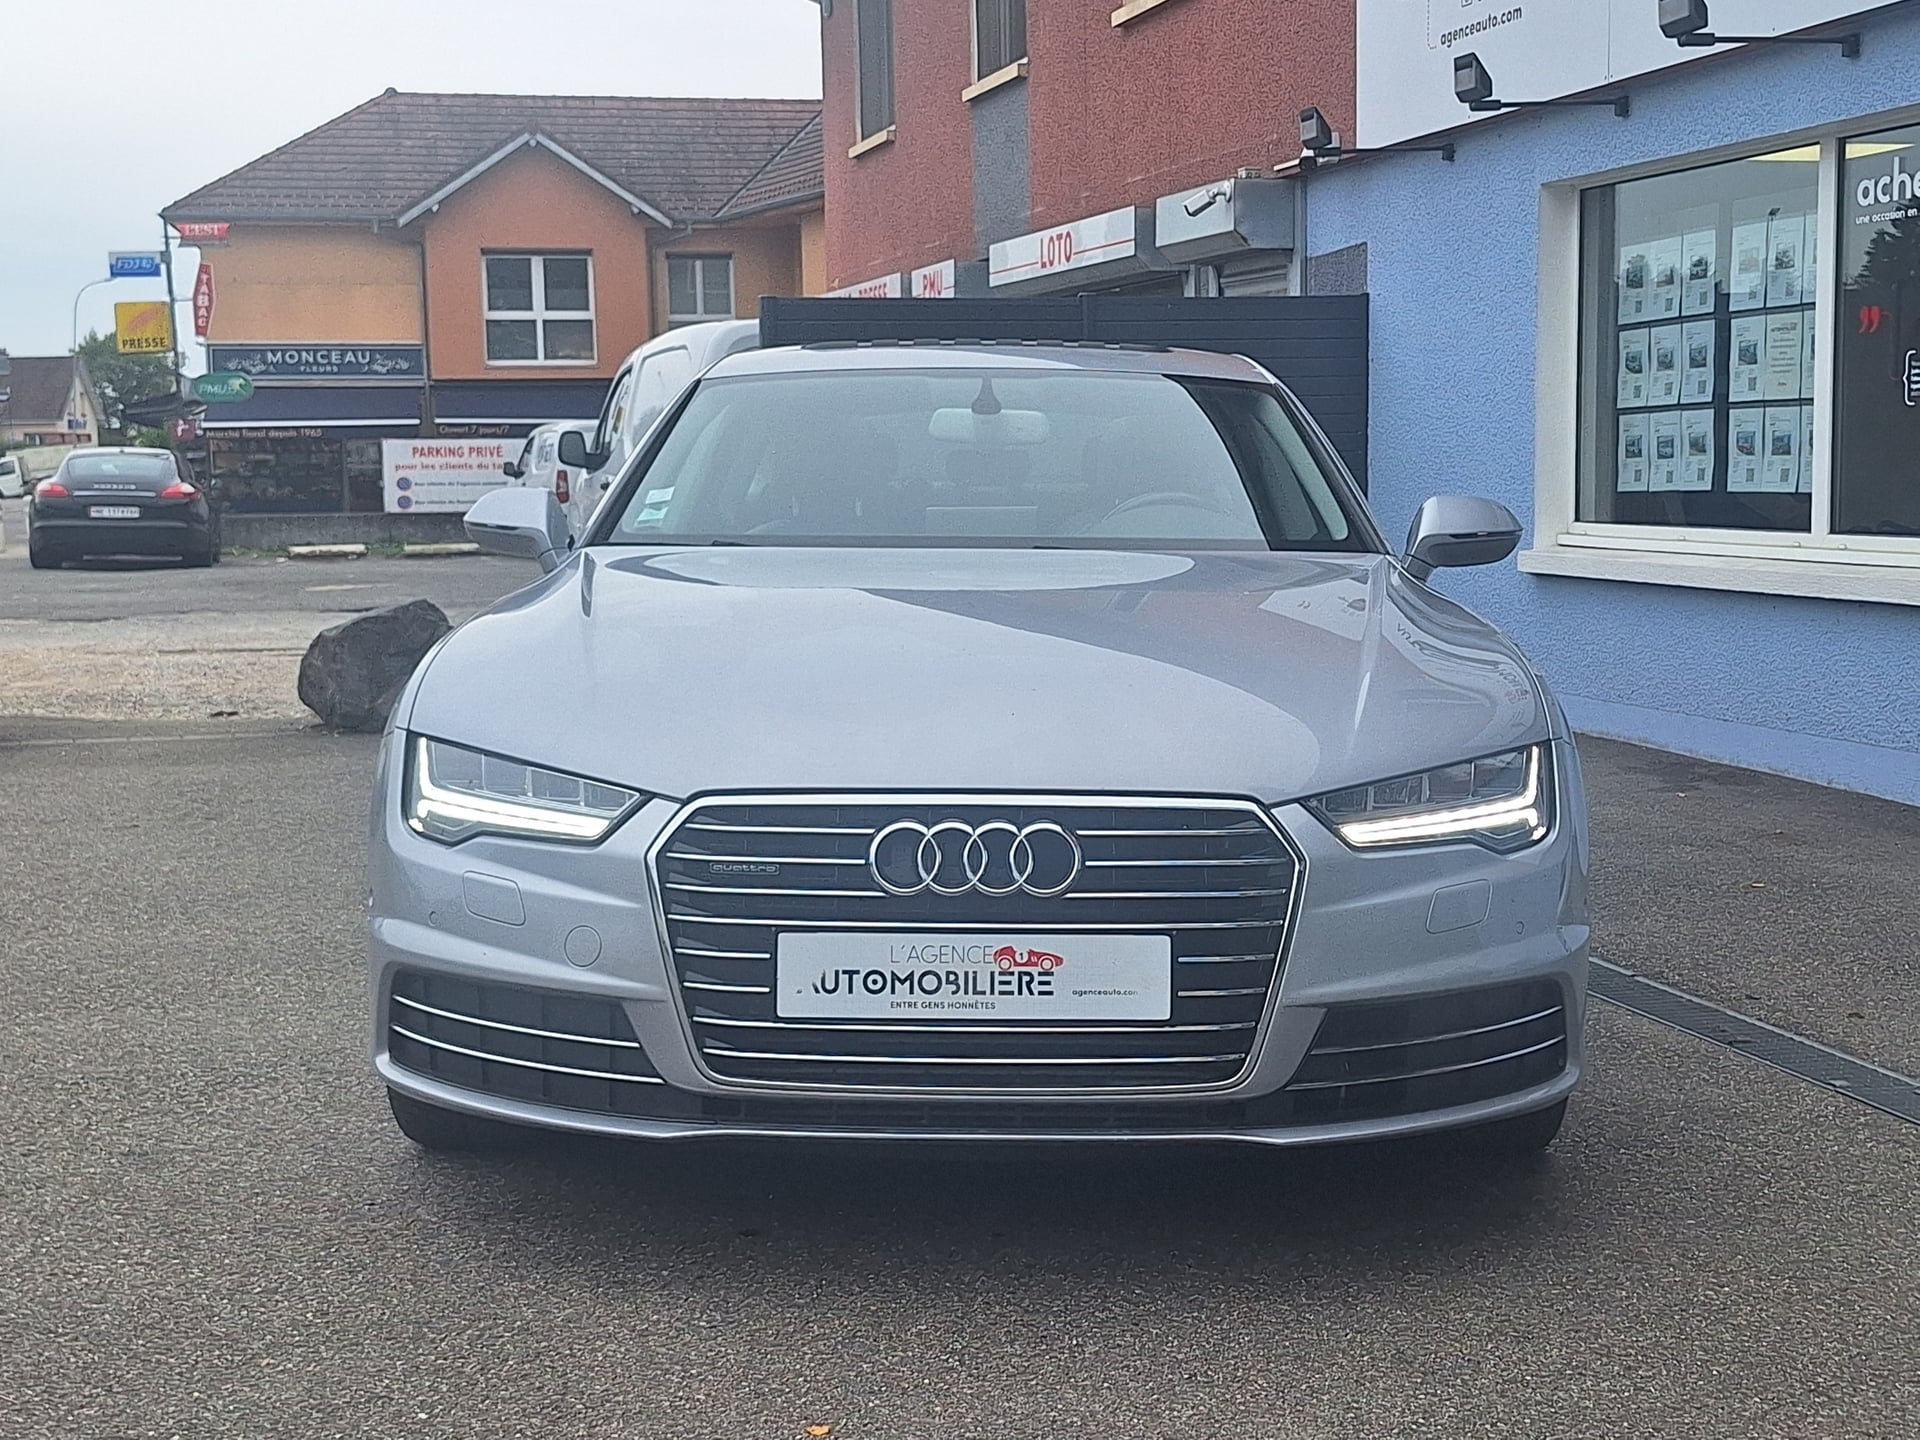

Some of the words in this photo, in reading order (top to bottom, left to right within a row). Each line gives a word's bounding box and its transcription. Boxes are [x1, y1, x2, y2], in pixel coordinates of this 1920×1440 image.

[1440, 6, 1522, 48] agenceauto.com
[1855, 215, 1870, 225] une
[1040, 231, 1073, 269] LOTO
[923, 269, 943, 298] PMU
[197, 272, 210, 327] TABAC
[122, 337, 166, 349] PRESSE
[266, 350, 370, 364] MONCEAU
[412, 446, 465, 458] PARKING
[469, 444, 504, 457] PRIVÉ
[713, 864, 777, 872] quattro
[890, 944, 994, 965] L'AGENCE
[890, 1001, 918, 1009] ENTRE
[921, 1001, 946, 1010] GENS
